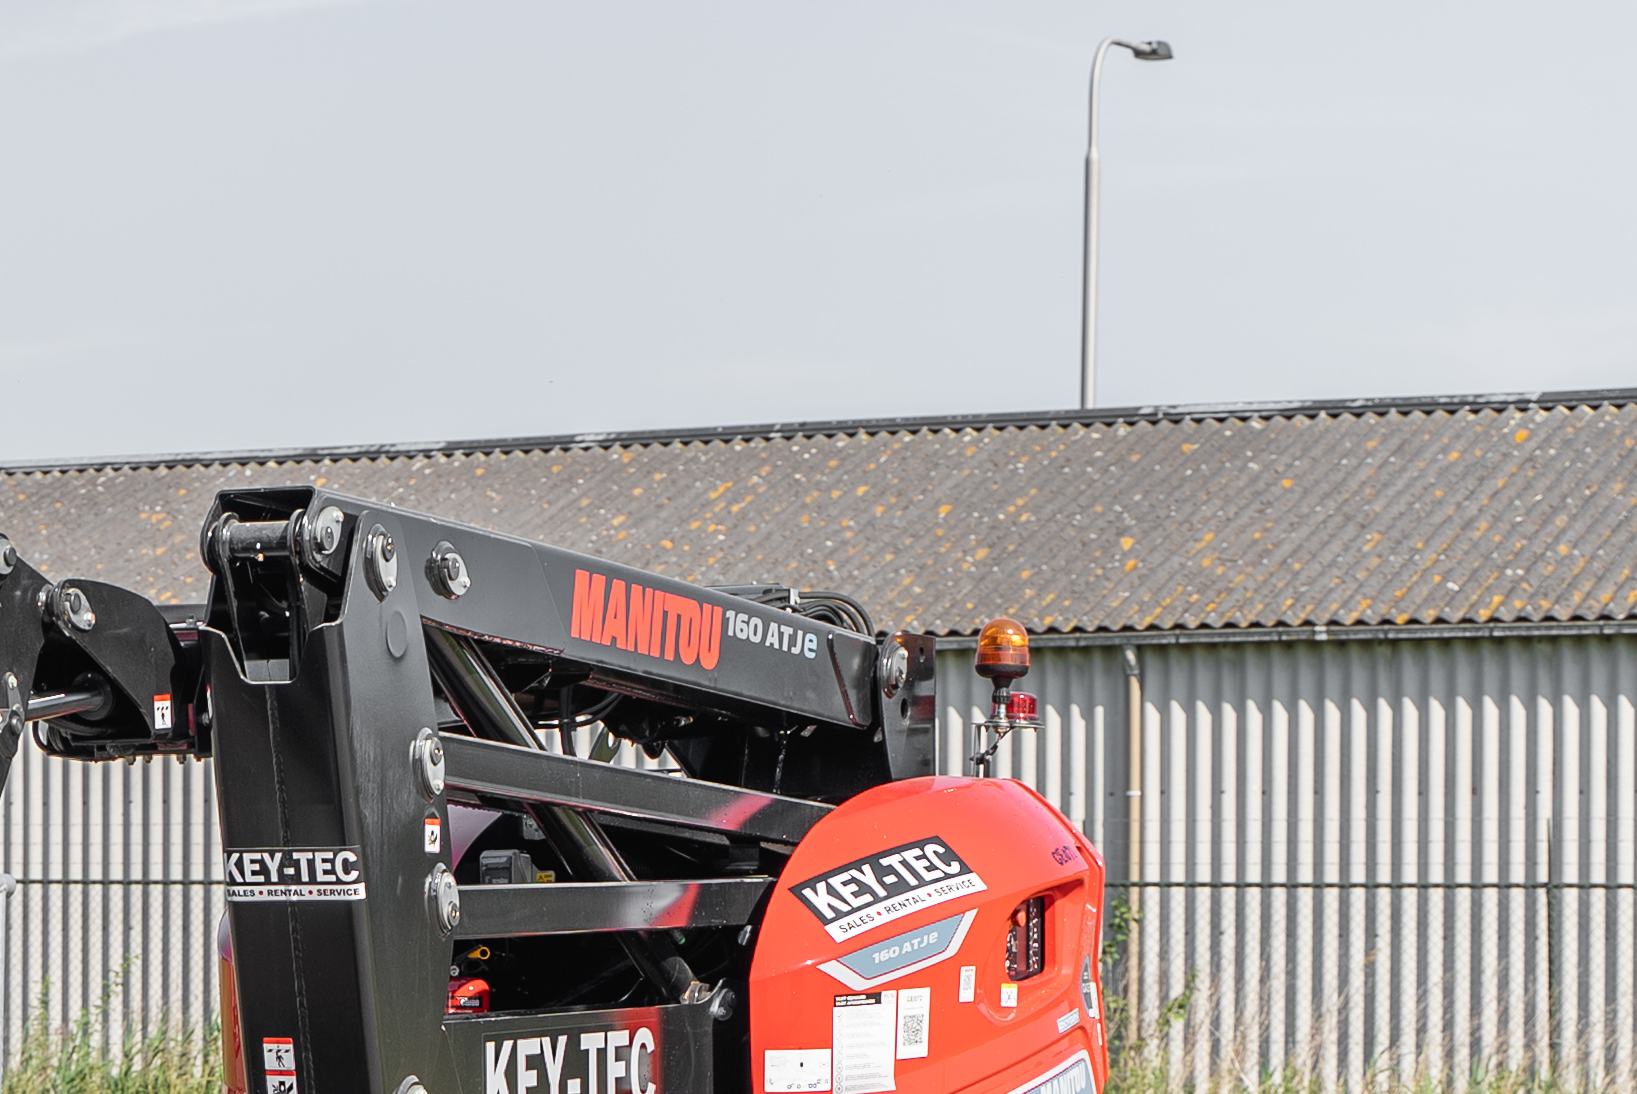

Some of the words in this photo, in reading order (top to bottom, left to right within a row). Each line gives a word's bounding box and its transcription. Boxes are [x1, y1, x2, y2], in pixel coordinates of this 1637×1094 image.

[570, 568, 723, 670] MANITOU
[725, 609, 763, 644] 160
[765, 622, 818, 659] ATJe
[223, 850, 360, 883] KEY-TEC
[801, 843, 961, 920] KEY-TEC
[226, 889, 256, 898] SALES
[266, 888, 306, 897] RENTAL
[316, 887, 360, 897] SERVICE
[838, 913, 875, 934] SALES
[884, 894, 924, 915] RENTAL
[934, 878, 976, 897] SERVICE
[872, 945, 900, 964] 160
[901, 931, 939, 955] ATJe
